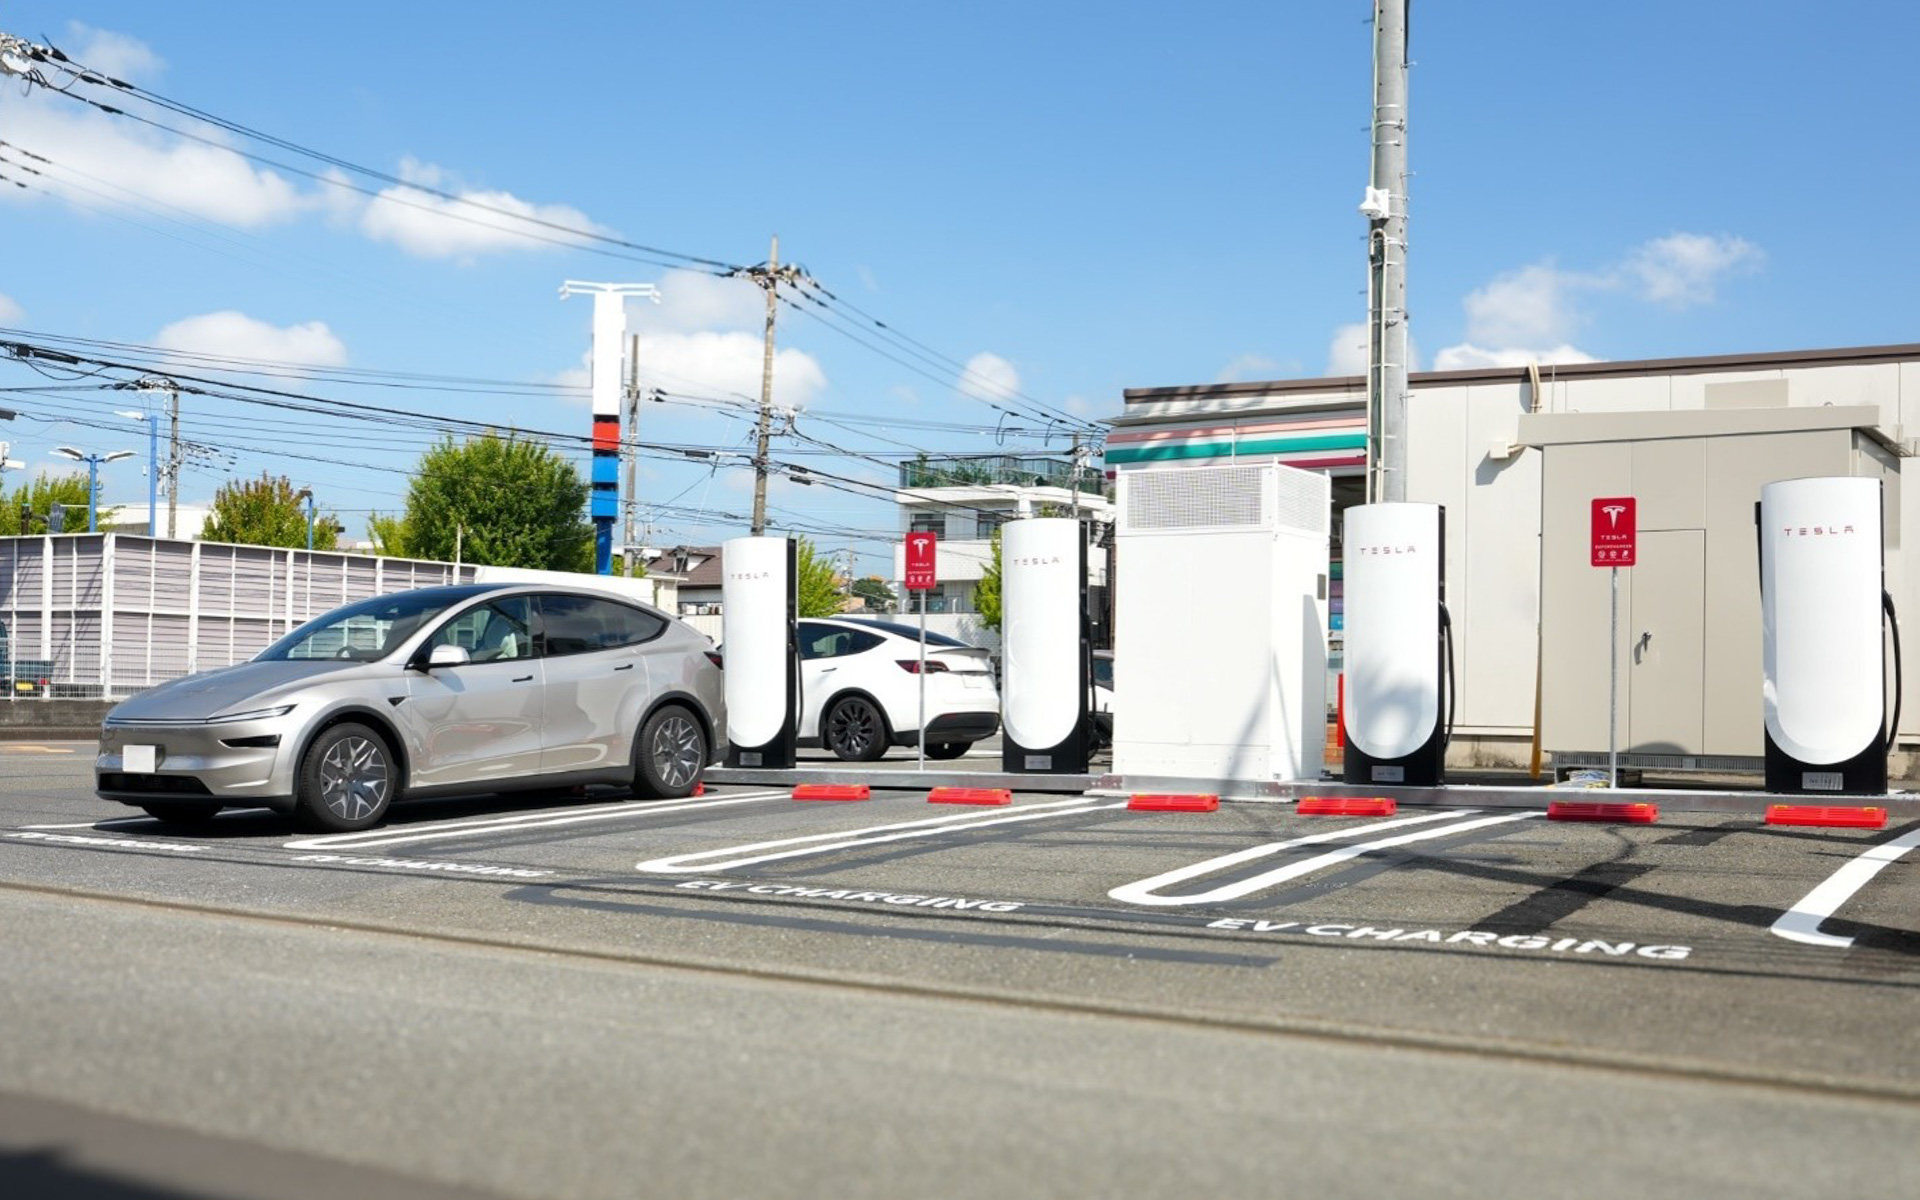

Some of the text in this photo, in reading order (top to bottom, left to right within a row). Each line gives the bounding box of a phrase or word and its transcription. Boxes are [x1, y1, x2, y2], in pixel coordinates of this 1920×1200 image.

[1784, 525, 1854, 537] TESLA
[1360, 545, 1416, 556] TESLA
[1013, 556, 1061, 566] TESLA
[730, 572, 769, 580] TESLA
[675, 880, 1026, 912] EV CHARGING
[1206, 917, 1694, 961] EV CHARGING
